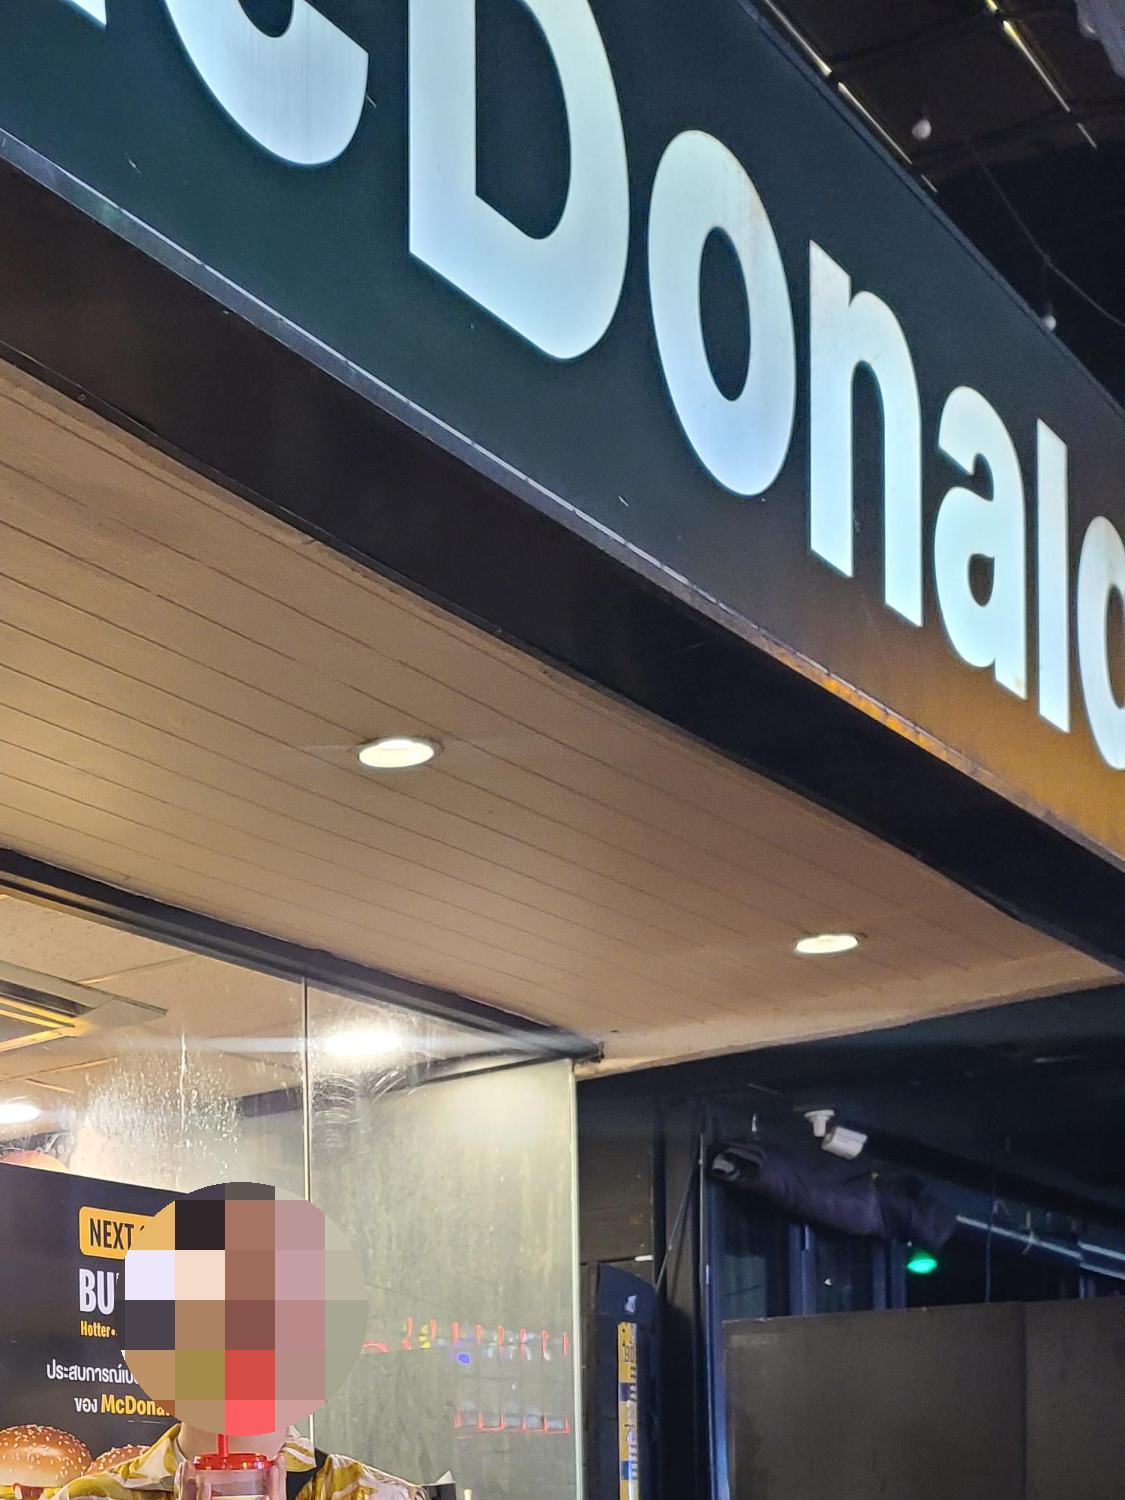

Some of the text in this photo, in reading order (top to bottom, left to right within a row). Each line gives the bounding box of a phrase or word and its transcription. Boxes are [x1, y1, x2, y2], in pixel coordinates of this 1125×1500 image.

[89, 1217, 135, 1250] NEXT
[79, 1268, 120, 1315] BU
[46, 1358, 139, 1385] ประสบการณ์เบ
[74, 1394, 170, 1417] ของ McDona
